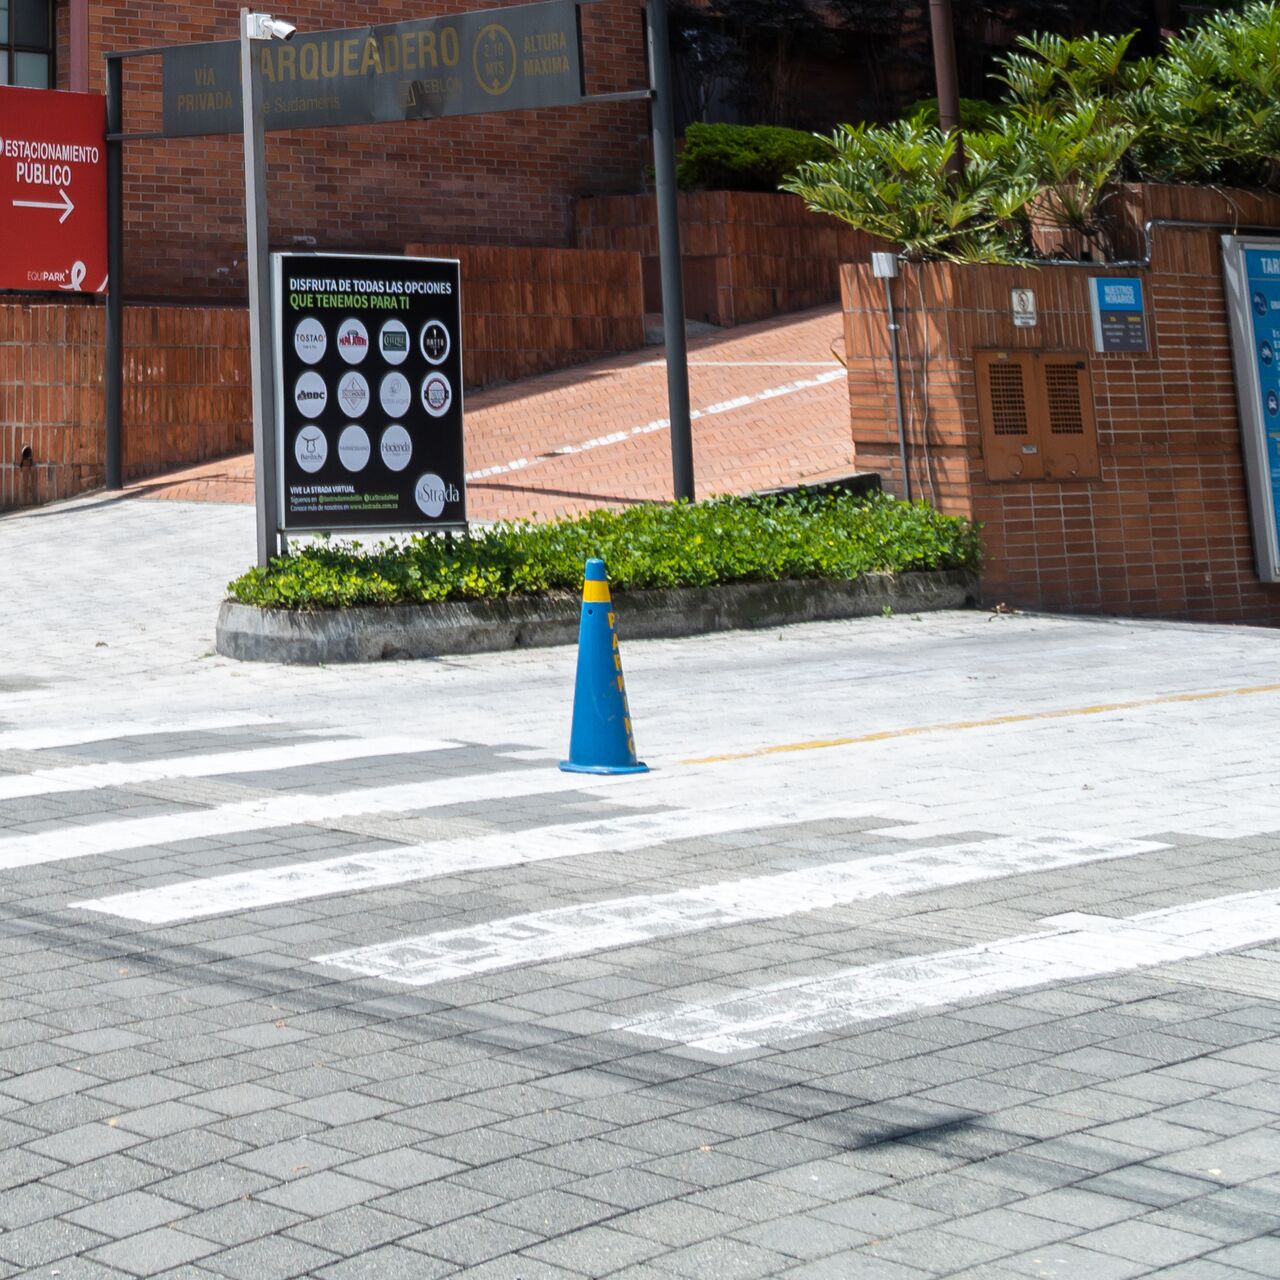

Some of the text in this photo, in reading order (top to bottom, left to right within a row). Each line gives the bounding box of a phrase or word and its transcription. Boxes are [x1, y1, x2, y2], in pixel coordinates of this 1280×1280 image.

[523, 31, 567, 53] ALTURA
[240, 26, 461, 83] ARQUEADERO
[194, 63, 216, 86] VÍA
[484, 61, 505, 75] MTS
[523, 55, 570, 77] MAXIMA
[176, 91, 233, 113] PRIVADA
[5, 139, 100, 165] ESTACIONAMIENTO
[15, 157, 72, 186] PÚBLICO
[26, 270, 66, 282] EQUIPARK
[289, 278, 452, 295] DISFRUTA DE TODAS LAS OPCIONES
[289, 293, 410, 310] QUE TENEMOS PARA TI
[289, 485, 355, 495] VIVE LA STRADA VIRTUAL
